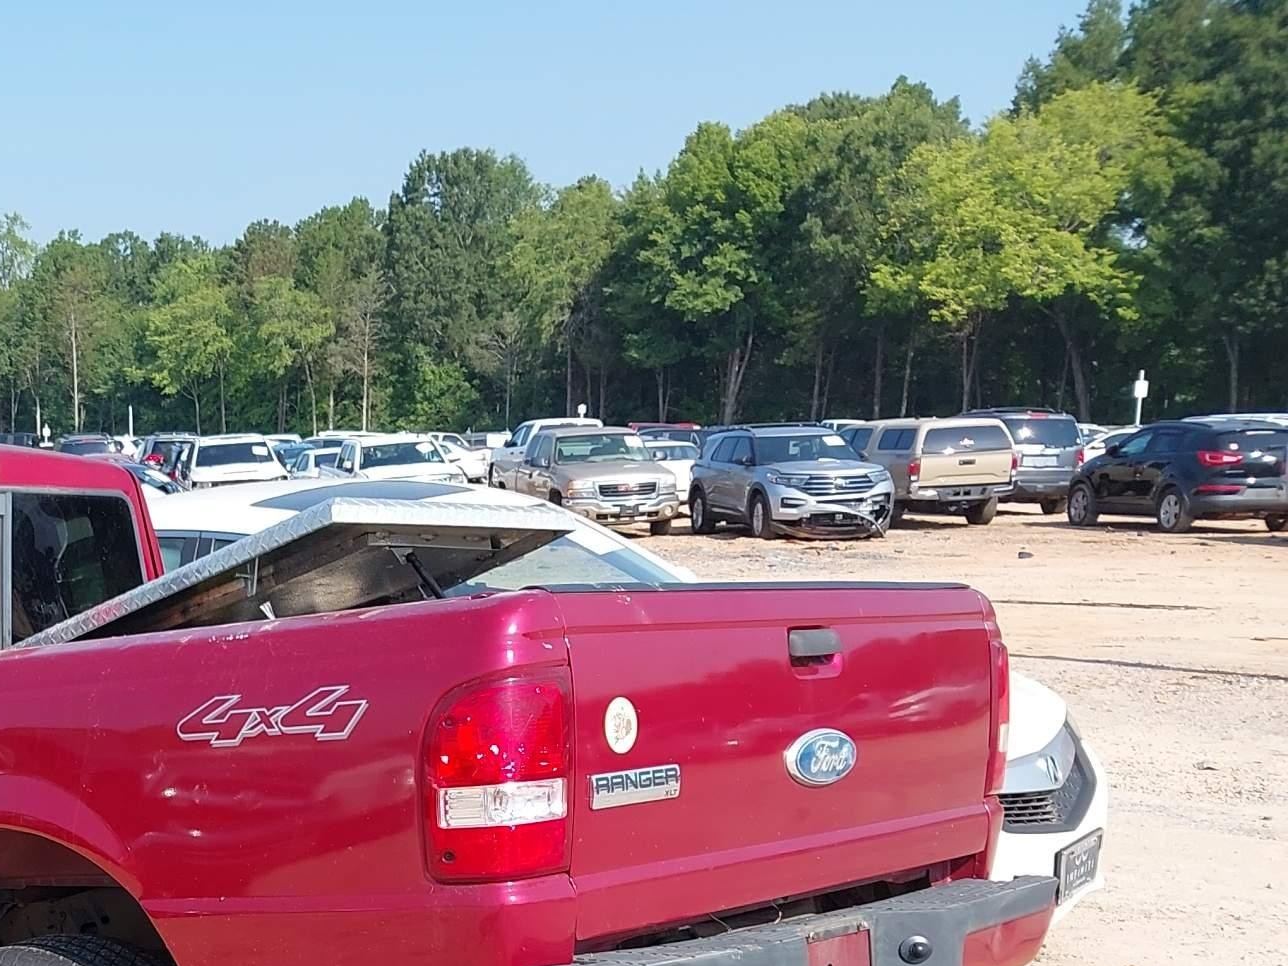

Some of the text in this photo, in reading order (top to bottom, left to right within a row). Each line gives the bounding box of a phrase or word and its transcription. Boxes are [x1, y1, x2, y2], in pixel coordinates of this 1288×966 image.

[177, 685, 369, 747] 4x4
[811, 740, 850, 773] Ford
[595, 767, 679, 794] RANGER
[664, 789, 678, 797] XLT
